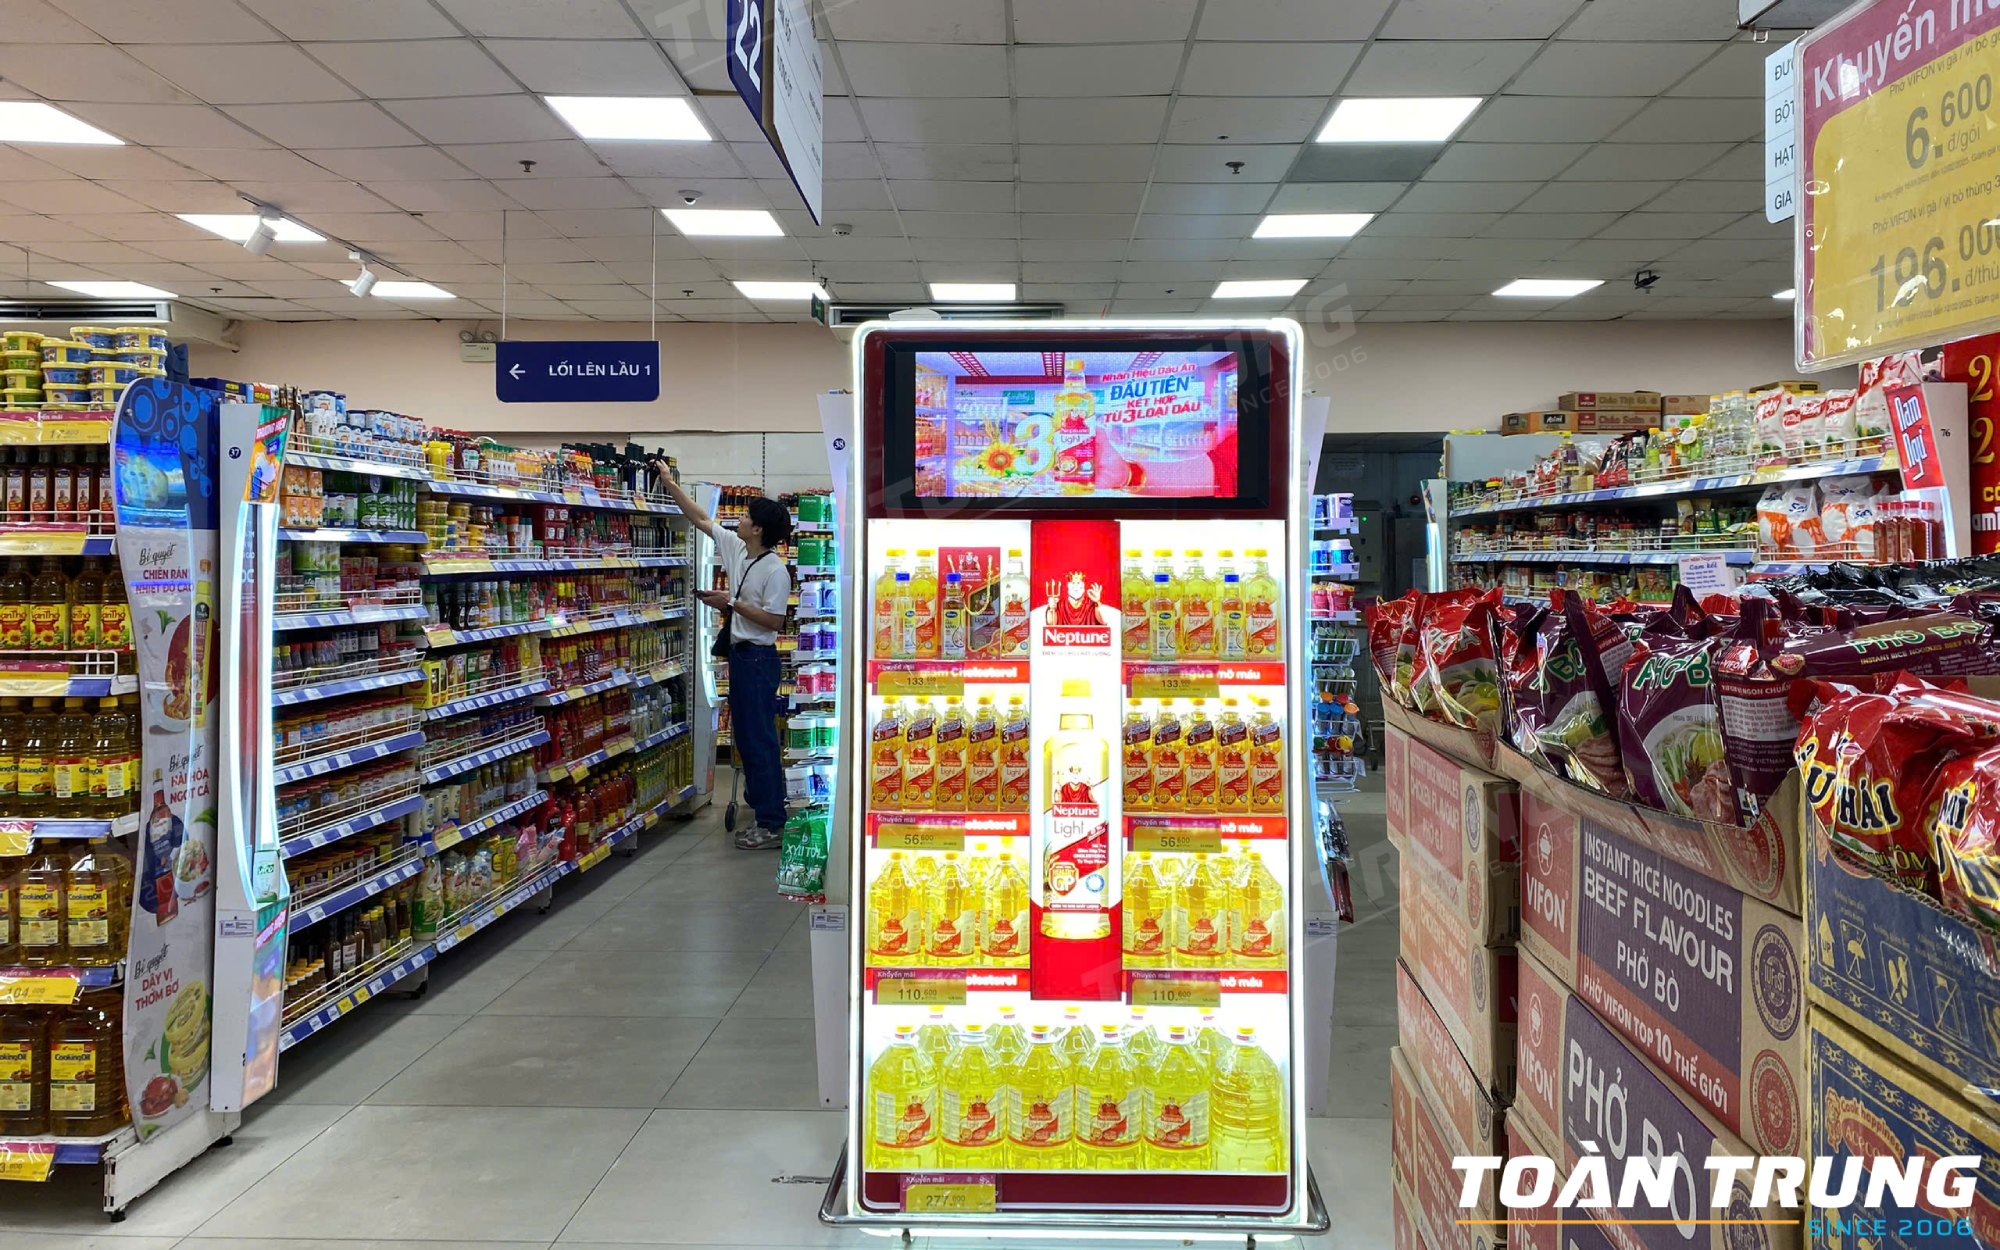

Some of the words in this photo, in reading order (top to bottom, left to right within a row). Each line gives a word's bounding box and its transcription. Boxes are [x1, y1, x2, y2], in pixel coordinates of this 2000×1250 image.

[1814, 0, 1935, 108] Khuyến
[1889, 83, 1905, 96] Phở
[1908, 63, 1936, 87] VIFON
[1937, 60, 1946, 72] vị
[1946, 54, 1958, 69] gà
[1965, 44, 1973, 56] vị
[1975, 36, 1988, 51] bò
[1947, 121, 1981, 152] đ/gói
[1774, 191, 1793, 210] GIA
[1872, 221, 1889, 235] Phở
[1889, 209, 1917, 228] VIFON
[1918, 203, 1926, 217] vị
[1926, 200, 1937, 219] gà
[1944, 194, 1952, 207] vị
[1952, 190, 1964, 205] bò
[1965, 180, 1992, 199] thùng
[549, 359, 573, 377] LỐI
[577, 361, 606, 377] LÊN
[609, 359, 640, 377] LẦU
[644, 365, 651, 377] 1
[1110, 378, 1151, 401] ĐẦU
[1122, 408, 1137, 425] 3
[1894, 395, 1922, 431] Nam
[1060, 434, 1082, 445] Light
[1941, 428, 1951, 438] 76
[229, 447, 240, 458] 37
[833, 439, 845, 450] 38
[1015, 414, 1055, 476] 3
[1902, 427, 1927, 481] Ngư
[151, 542, 178, 566] quyết
[142, 568, 169, 581] CHIÊN
[170, 566, 189, 579] RÁN
[1044, 628, 1110, 646] Neptune
[1860, 654, 1890, 665] INSTANT
[1891, 650, 1908, 661] RICE
[1908, 644, 1943, 657] NOODLES
[1236, 668, 1261, 680] máu
[1722, 659, 1746, 671] VIFON
[1742, 686, 1764, 695] NGON
[196, 782, 210, 798] CÁ
[1053, 805, 1099, 817] Neptune
[965, 818, 1017, 831] olesterol
[1053, 820, 1085, 838] Light
[1238, 822, 1263, 833] máu
[1585, 832, 1631, 876] INSTANT
[1633, 859, 1660, 898] RICE
[1662, 876, 1733, 941] NOODLES
[1526, 871, 1565, 933] VIFON
[1584, 868, 1628, 919] BEEF
[1633, 898, 1733, 995] FLAVOUR
[966, 974, 1017, 986] olesterol
[1238, 976, 1263, 987] máu
[1617, 940, 1649, 990] PHỞ
[1654, 969, 1680, 1013] BÒ
[135, 991, 165, 1012] THƠM
[1583, 974, 1603, 1006] PHỞ
[1603, 991, 1632, 1029] VIFON
[1633, 1016, 1654, 1048] TOP
[1655, 1028, 1673, 1065] 10
[1674, 1051, 1698, 1088] THẾ
[1700, 1077, 1728, 1115] GIỚI
[54, 1053, 91, 1062] CookingOil
[1519, 1034, 1555, 1111] VIFON
[1567, 1038, 1628, 1161] PHỞ
[1840, 1095, 1861, 1113] Cook
